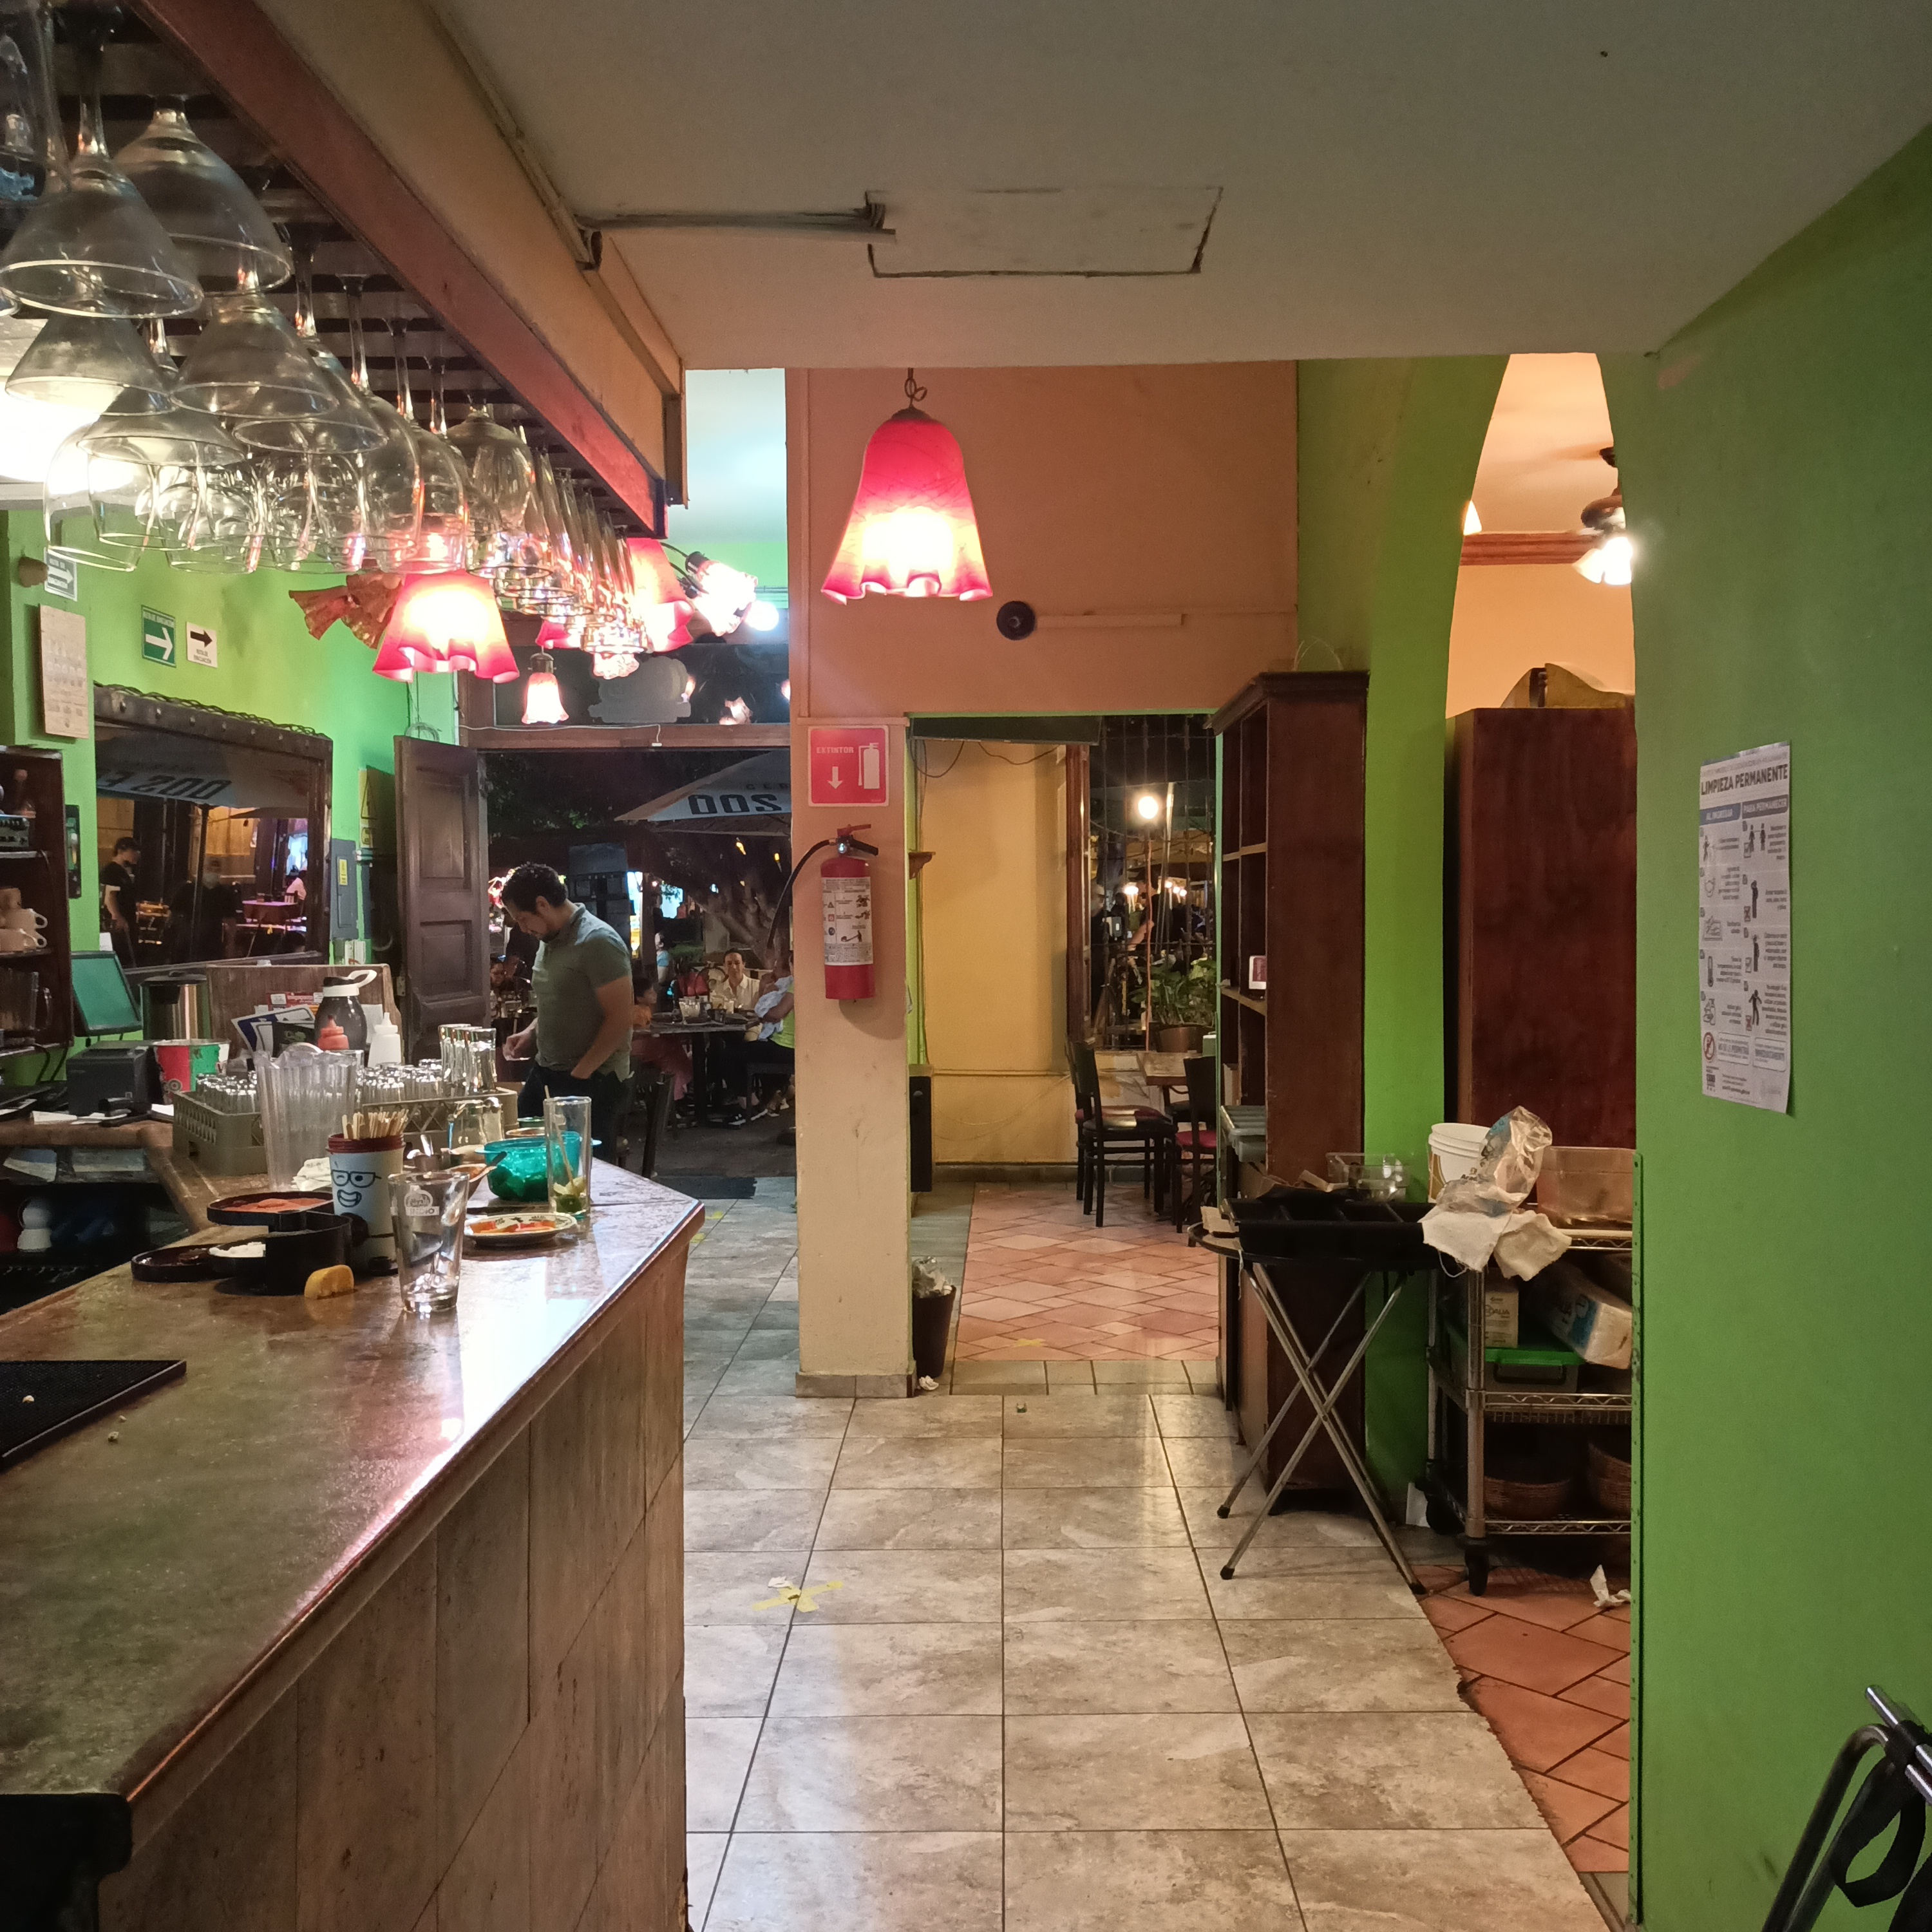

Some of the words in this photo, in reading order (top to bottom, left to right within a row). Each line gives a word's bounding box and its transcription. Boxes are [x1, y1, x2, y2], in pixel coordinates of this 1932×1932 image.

[1701, 776, 1734, 795] LIMPIEZA
[1735, 764, 1788, 788] PERMANENTE
[688, 794, 782, 815] DOS
